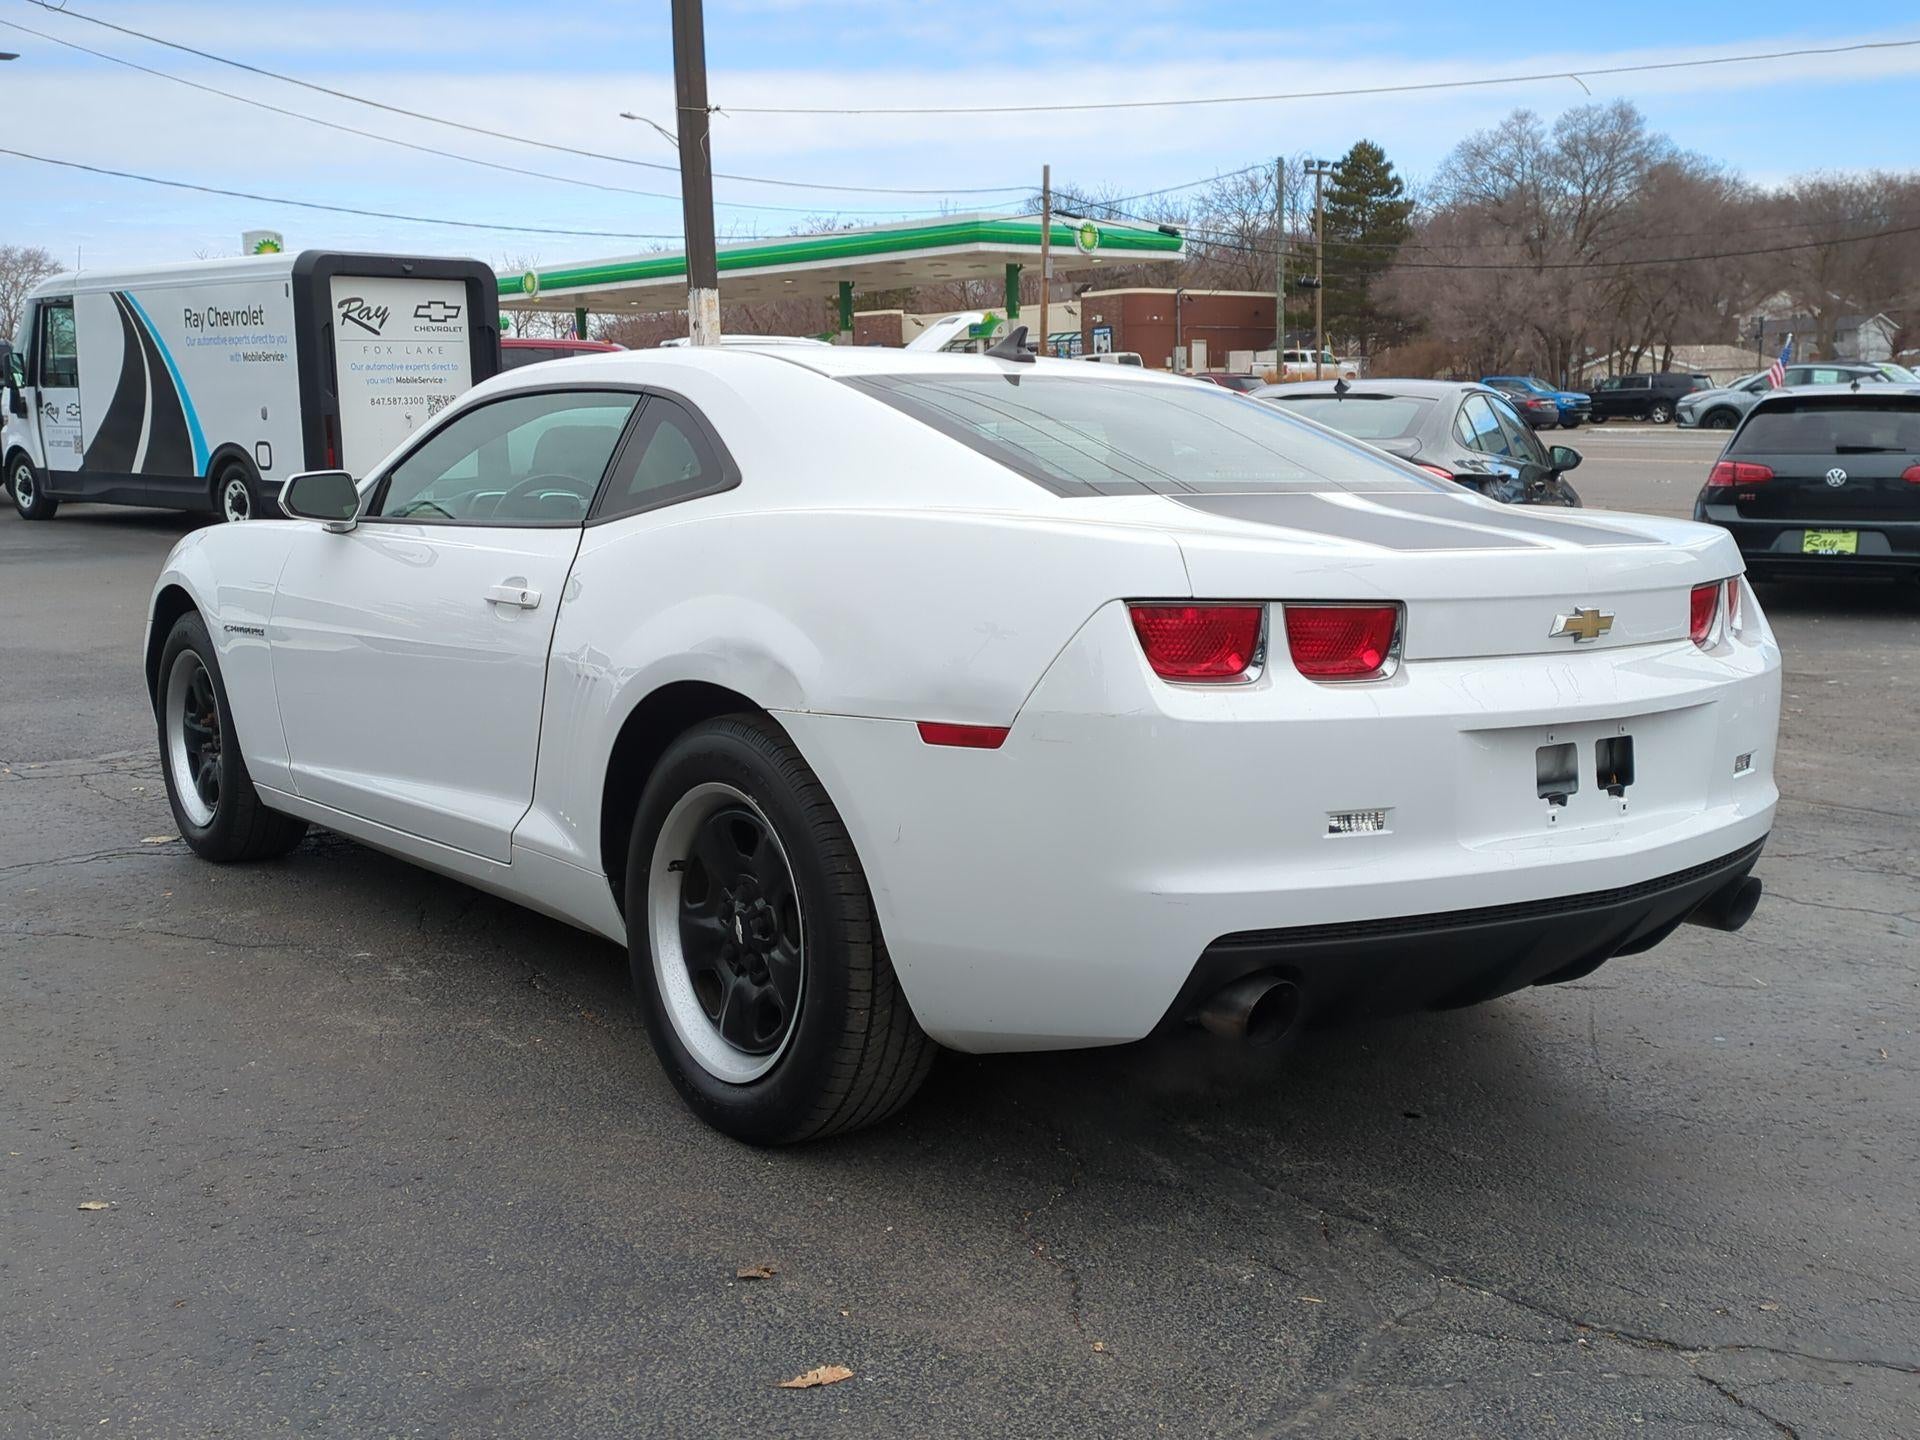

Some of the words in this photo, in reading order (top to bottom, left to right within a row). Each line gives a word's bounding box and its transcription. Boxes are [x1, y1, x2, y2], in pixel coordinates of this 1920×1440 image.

[184, 308, 204, 333] Ray
[207, 304, 264, 327] Chevrolet
[337, 297, 390, 336] Ray
[269, 334, 275, 344] to
[276, 335, 287, 346] you
[363, 346, 392, 355] FOX
[405, 346, 444, 355] LAKE
[350, 362, 364, 371] Our
[365, 362, 404, 371] automotive
[405, 362, 430, 372] experts
[431, 362, 450, 371] direct
[450, 363, 459, 371] to
[366, 378, 379, 386] you
[380, 377, 395, 385] with
[370, 396, 424, 407] 847.587.3300
[1804, 534, 1838, 549] Ray
